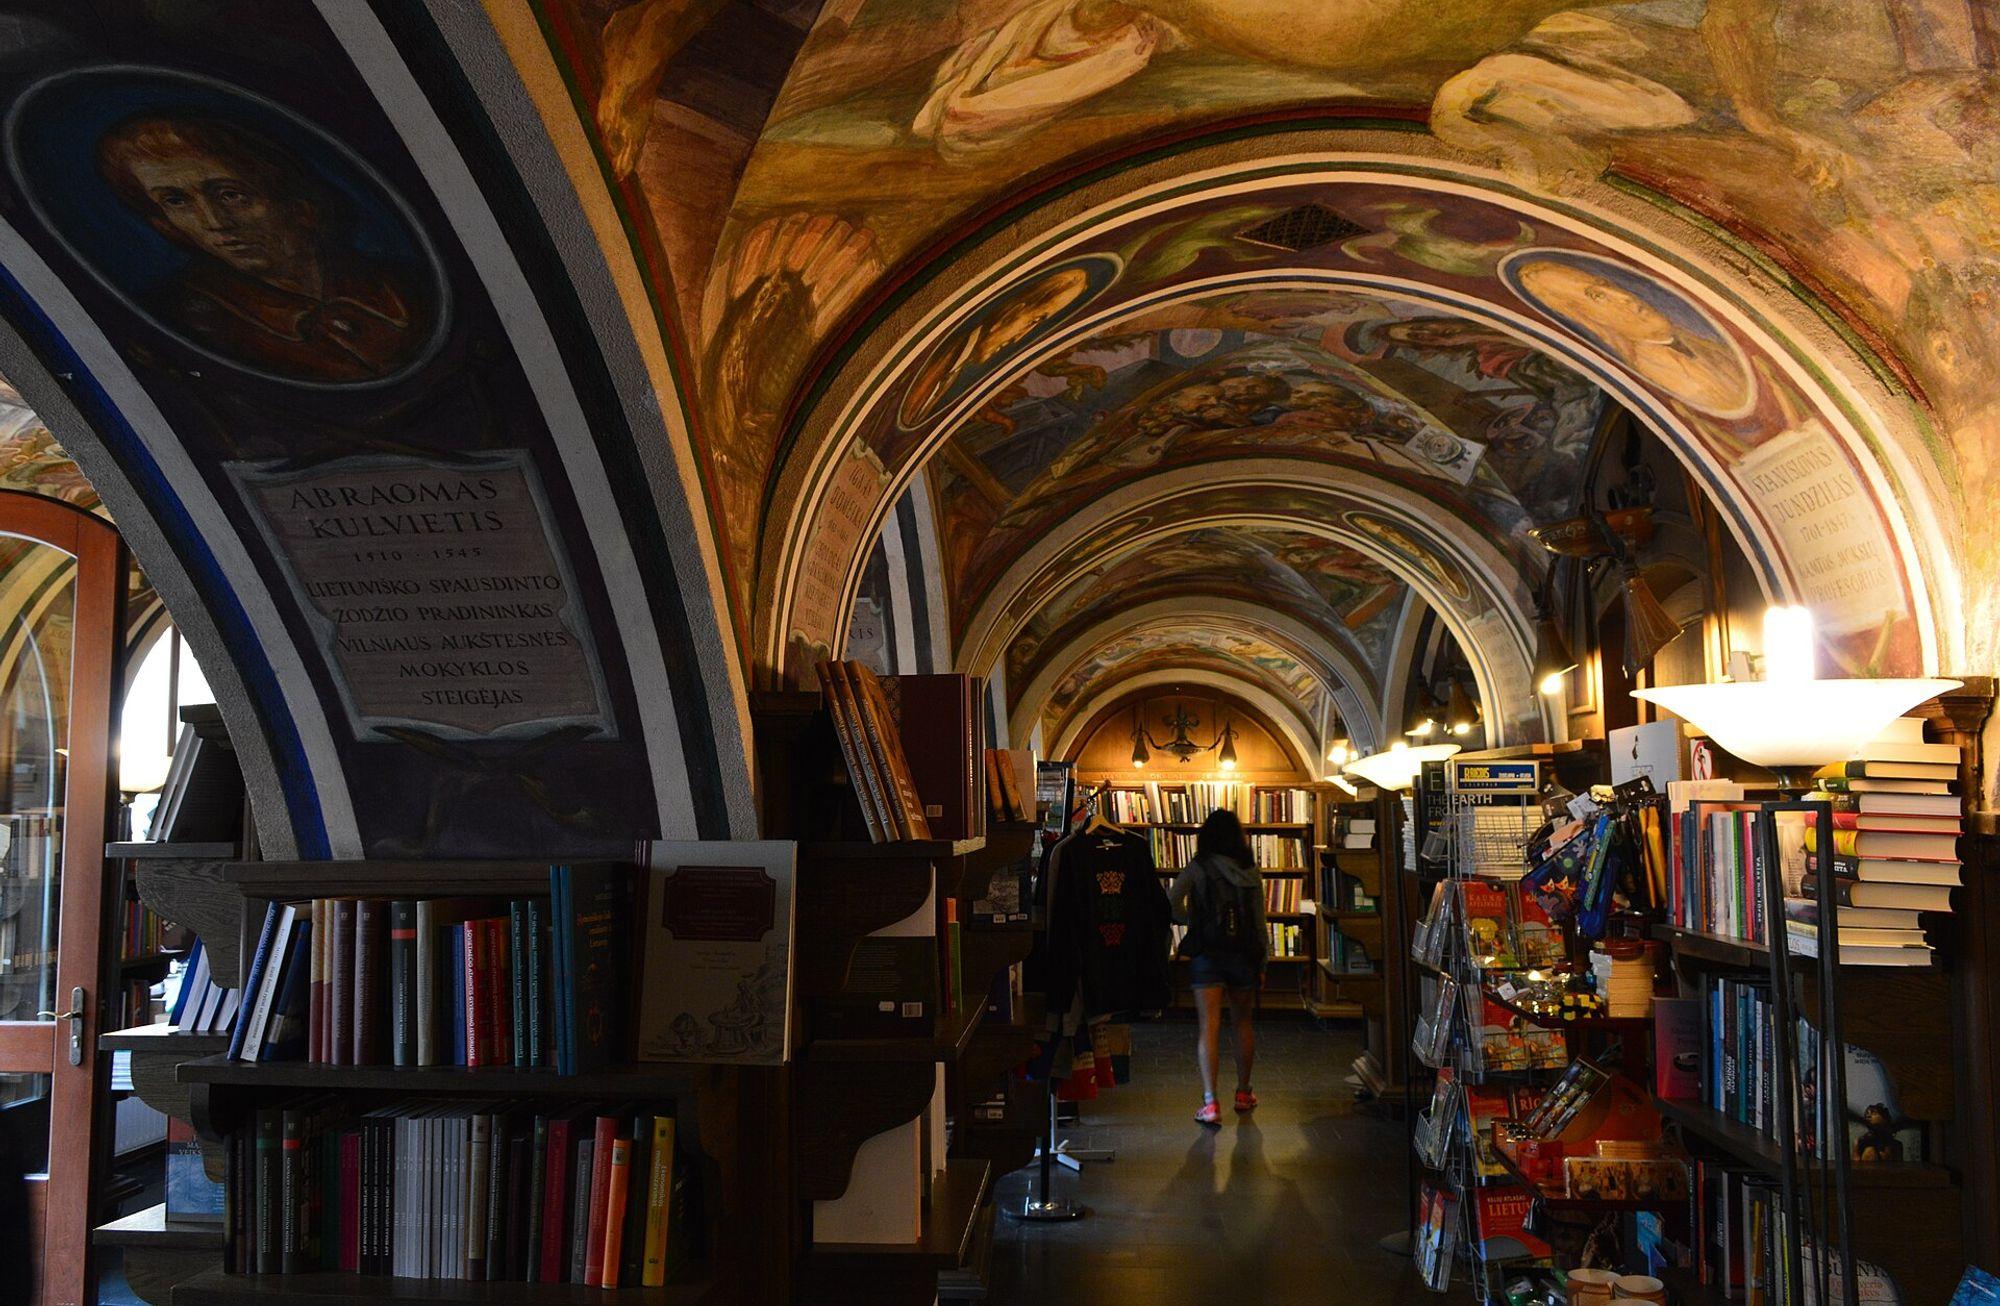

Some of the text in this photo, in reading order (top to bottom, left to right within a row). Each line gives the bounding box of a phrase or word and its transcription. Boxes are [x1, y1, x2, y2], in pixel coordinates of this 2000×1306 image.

[1753, 451, 1833, 496] STANISLOVAS
[291, 478, 498, 509] ABRAOMAS
[308, 511, 505, 539] KULVIETIS
[354, 547, 482, 563] 1510 1545
[306, 574, 561, 599] LIETUVIŠKO SPAUSDINTO
[416, 602, 554, 622] PRADININKAS
[336, 629, 569, 653] VILNIAUS AUKŠTESNĖS
[400, 659, 530, 679] MOKYKLOS
[422, 686, 524, 709] STEIGĖJAS
[1451, 793, 1493, 805] EARTH
